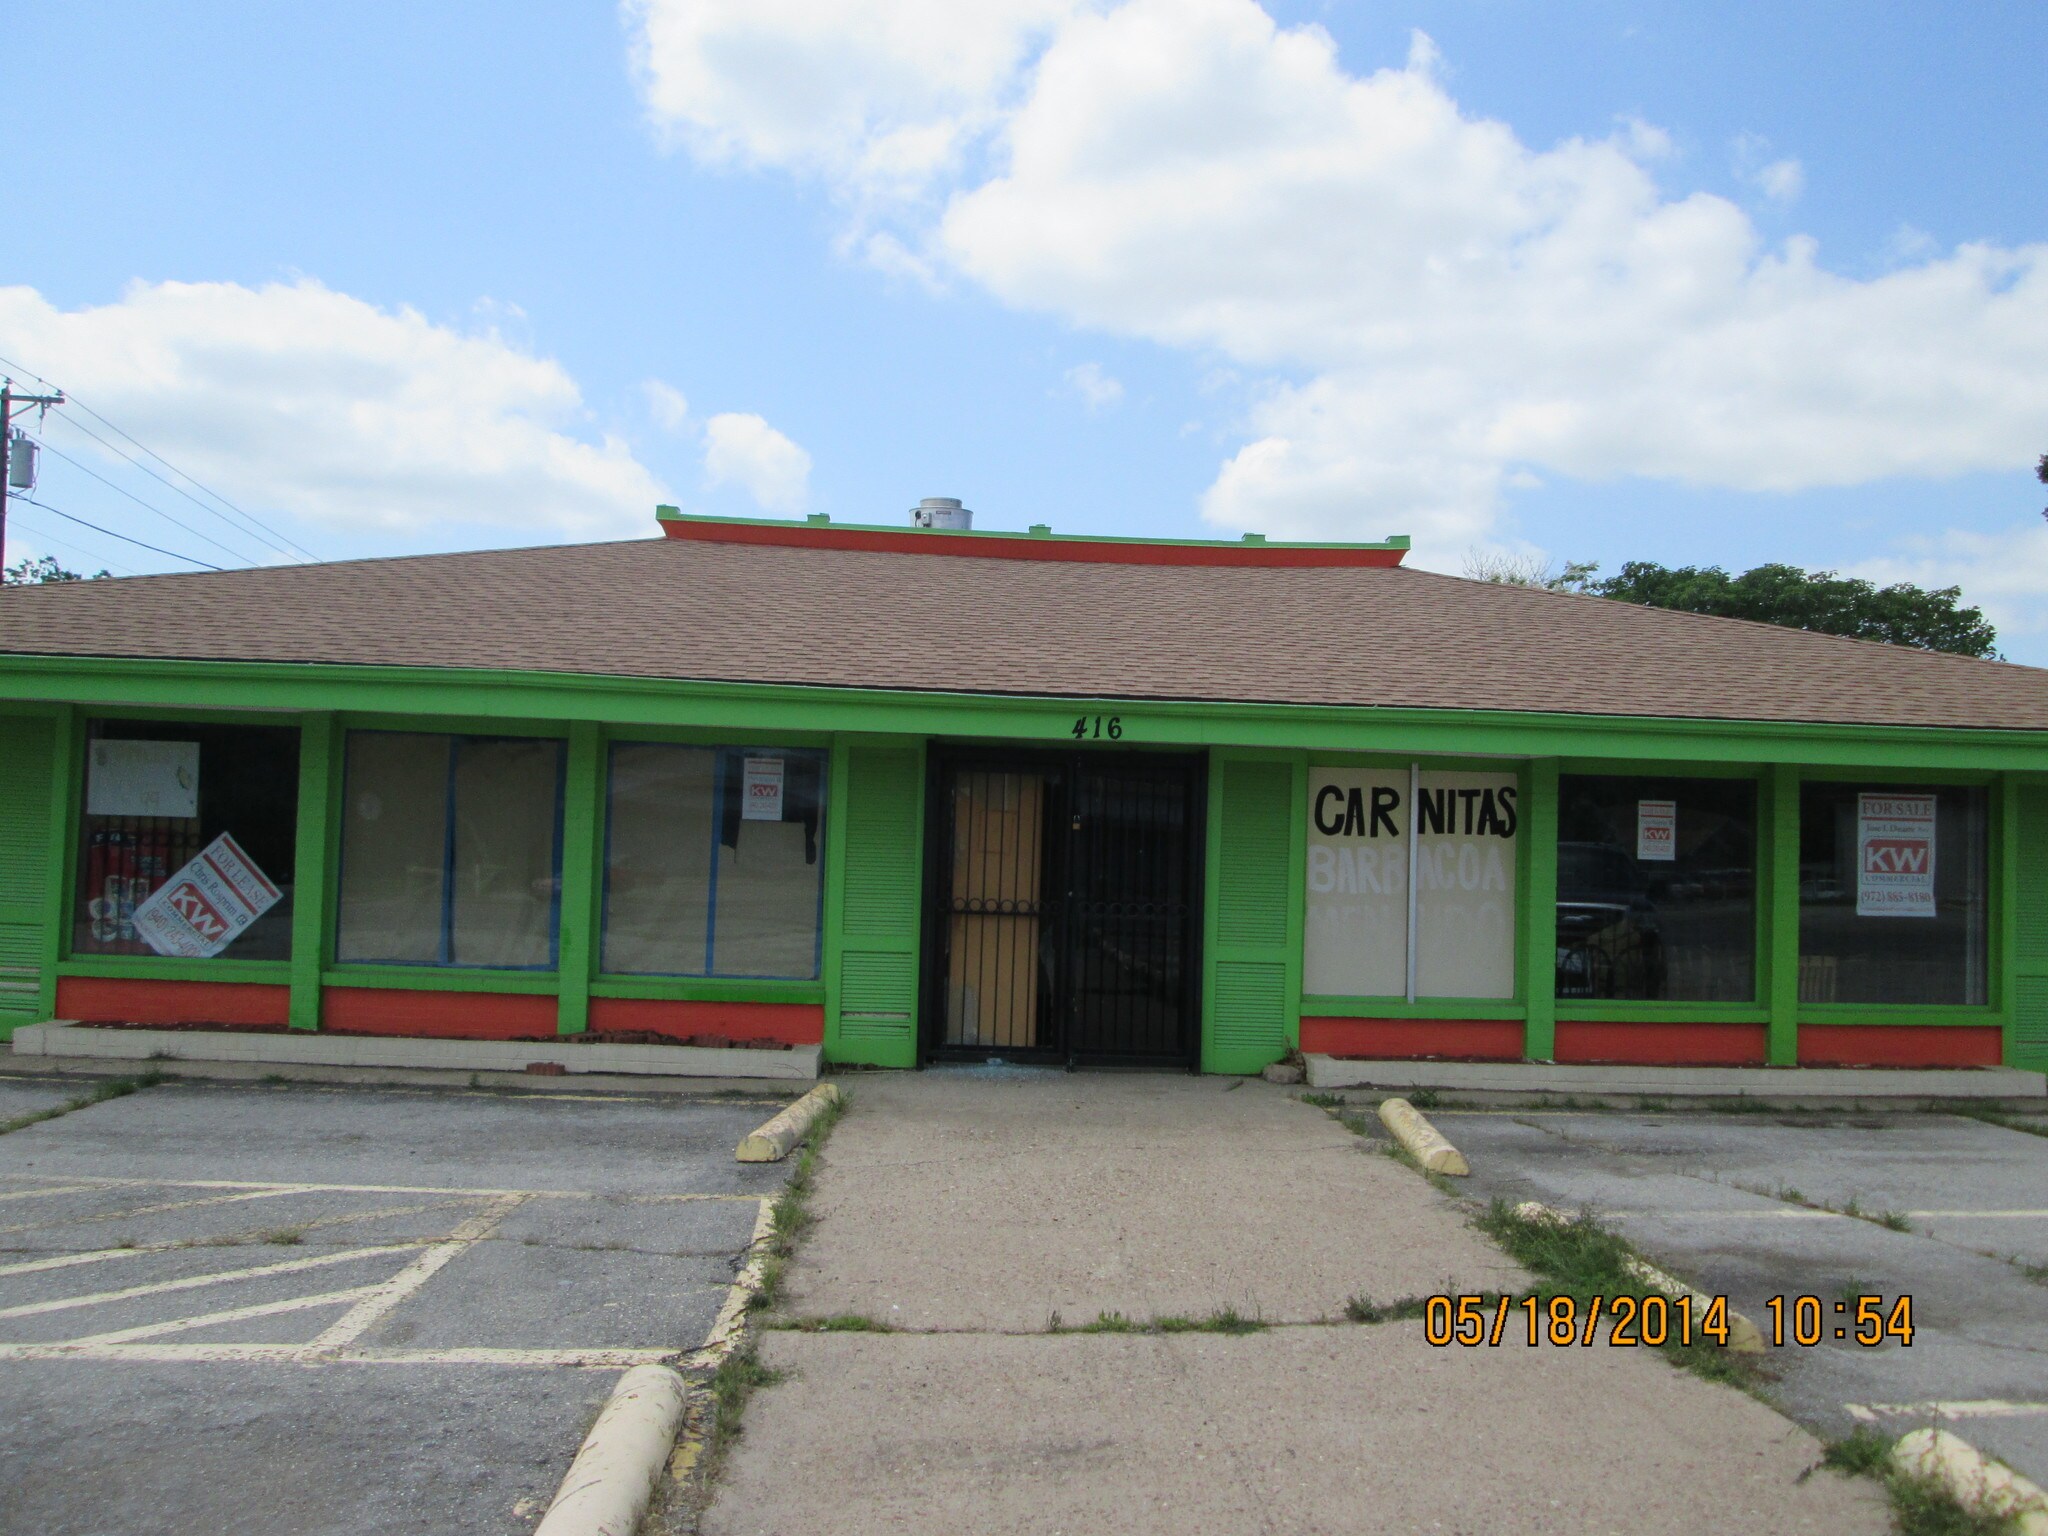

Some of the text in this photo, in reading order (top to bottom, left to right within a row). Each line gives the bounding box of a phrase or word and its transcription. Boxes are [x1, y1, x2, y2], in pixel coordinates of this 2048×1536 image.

[1072, 716, 1122, 740] 416
[751, 786, 777, 796] KW
[1863, 801, 1931, 817] FOR SALE
[1644, 830, 1669, 840] KW
[1866, 847, 1927, 872] KW
[190, 861, 209, 886] Chris
[210, 845, 268, 910] FOR LEASE
[1861, 891, 1886, 903] (972)
[170, 885, 225, 939] KW
